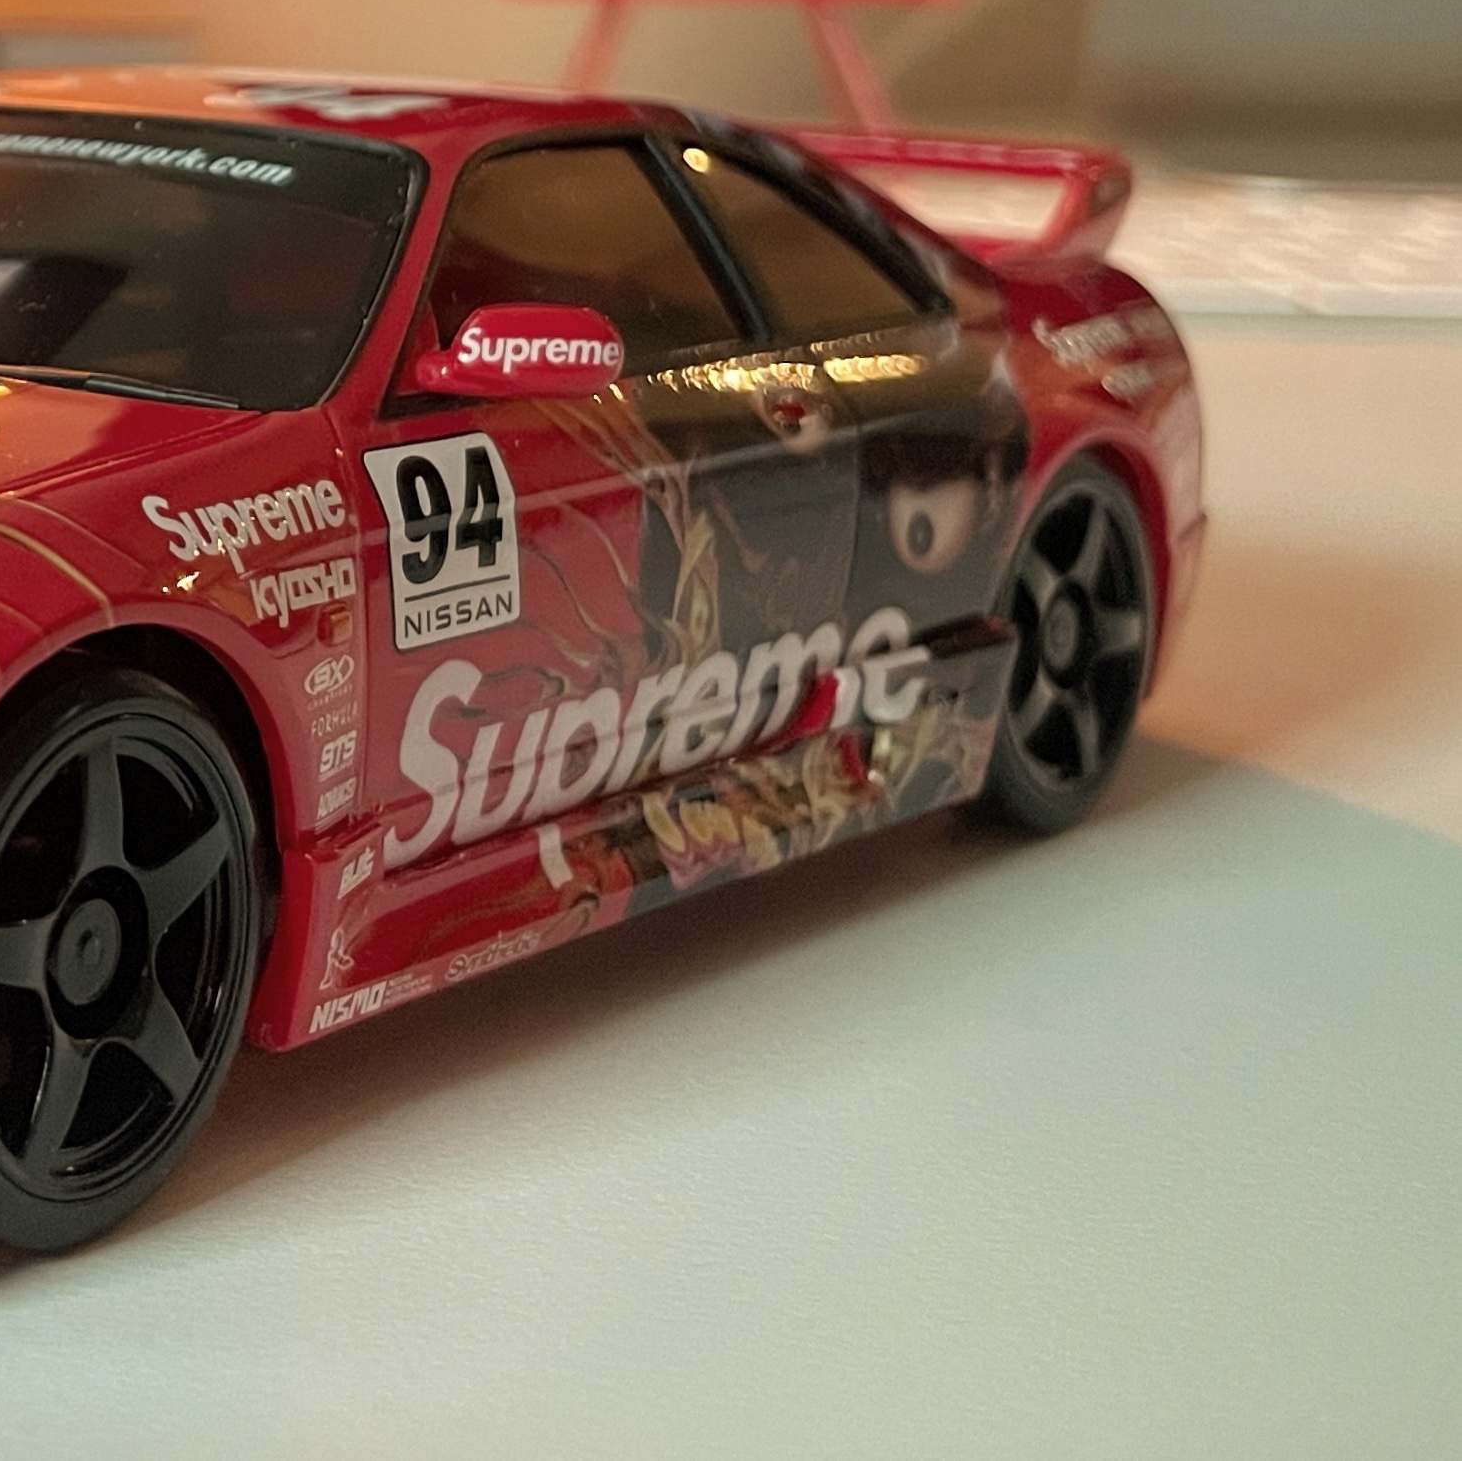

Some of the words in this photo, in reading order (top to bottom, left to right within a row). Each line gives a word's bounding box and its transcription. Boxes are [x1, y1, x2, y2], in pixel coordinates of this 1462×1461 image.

[457, 326, 620, 374] Supreme
[141, 479, 346, 574] Supreme
[395, 445, 504, 585] 94
[249, 556, 357, 629] KYOSHO
[403, 590, 514, 639] NISSAN
[382, 605, 931, 890] Supreme
[308, 980, 388, 1034] NISMO
